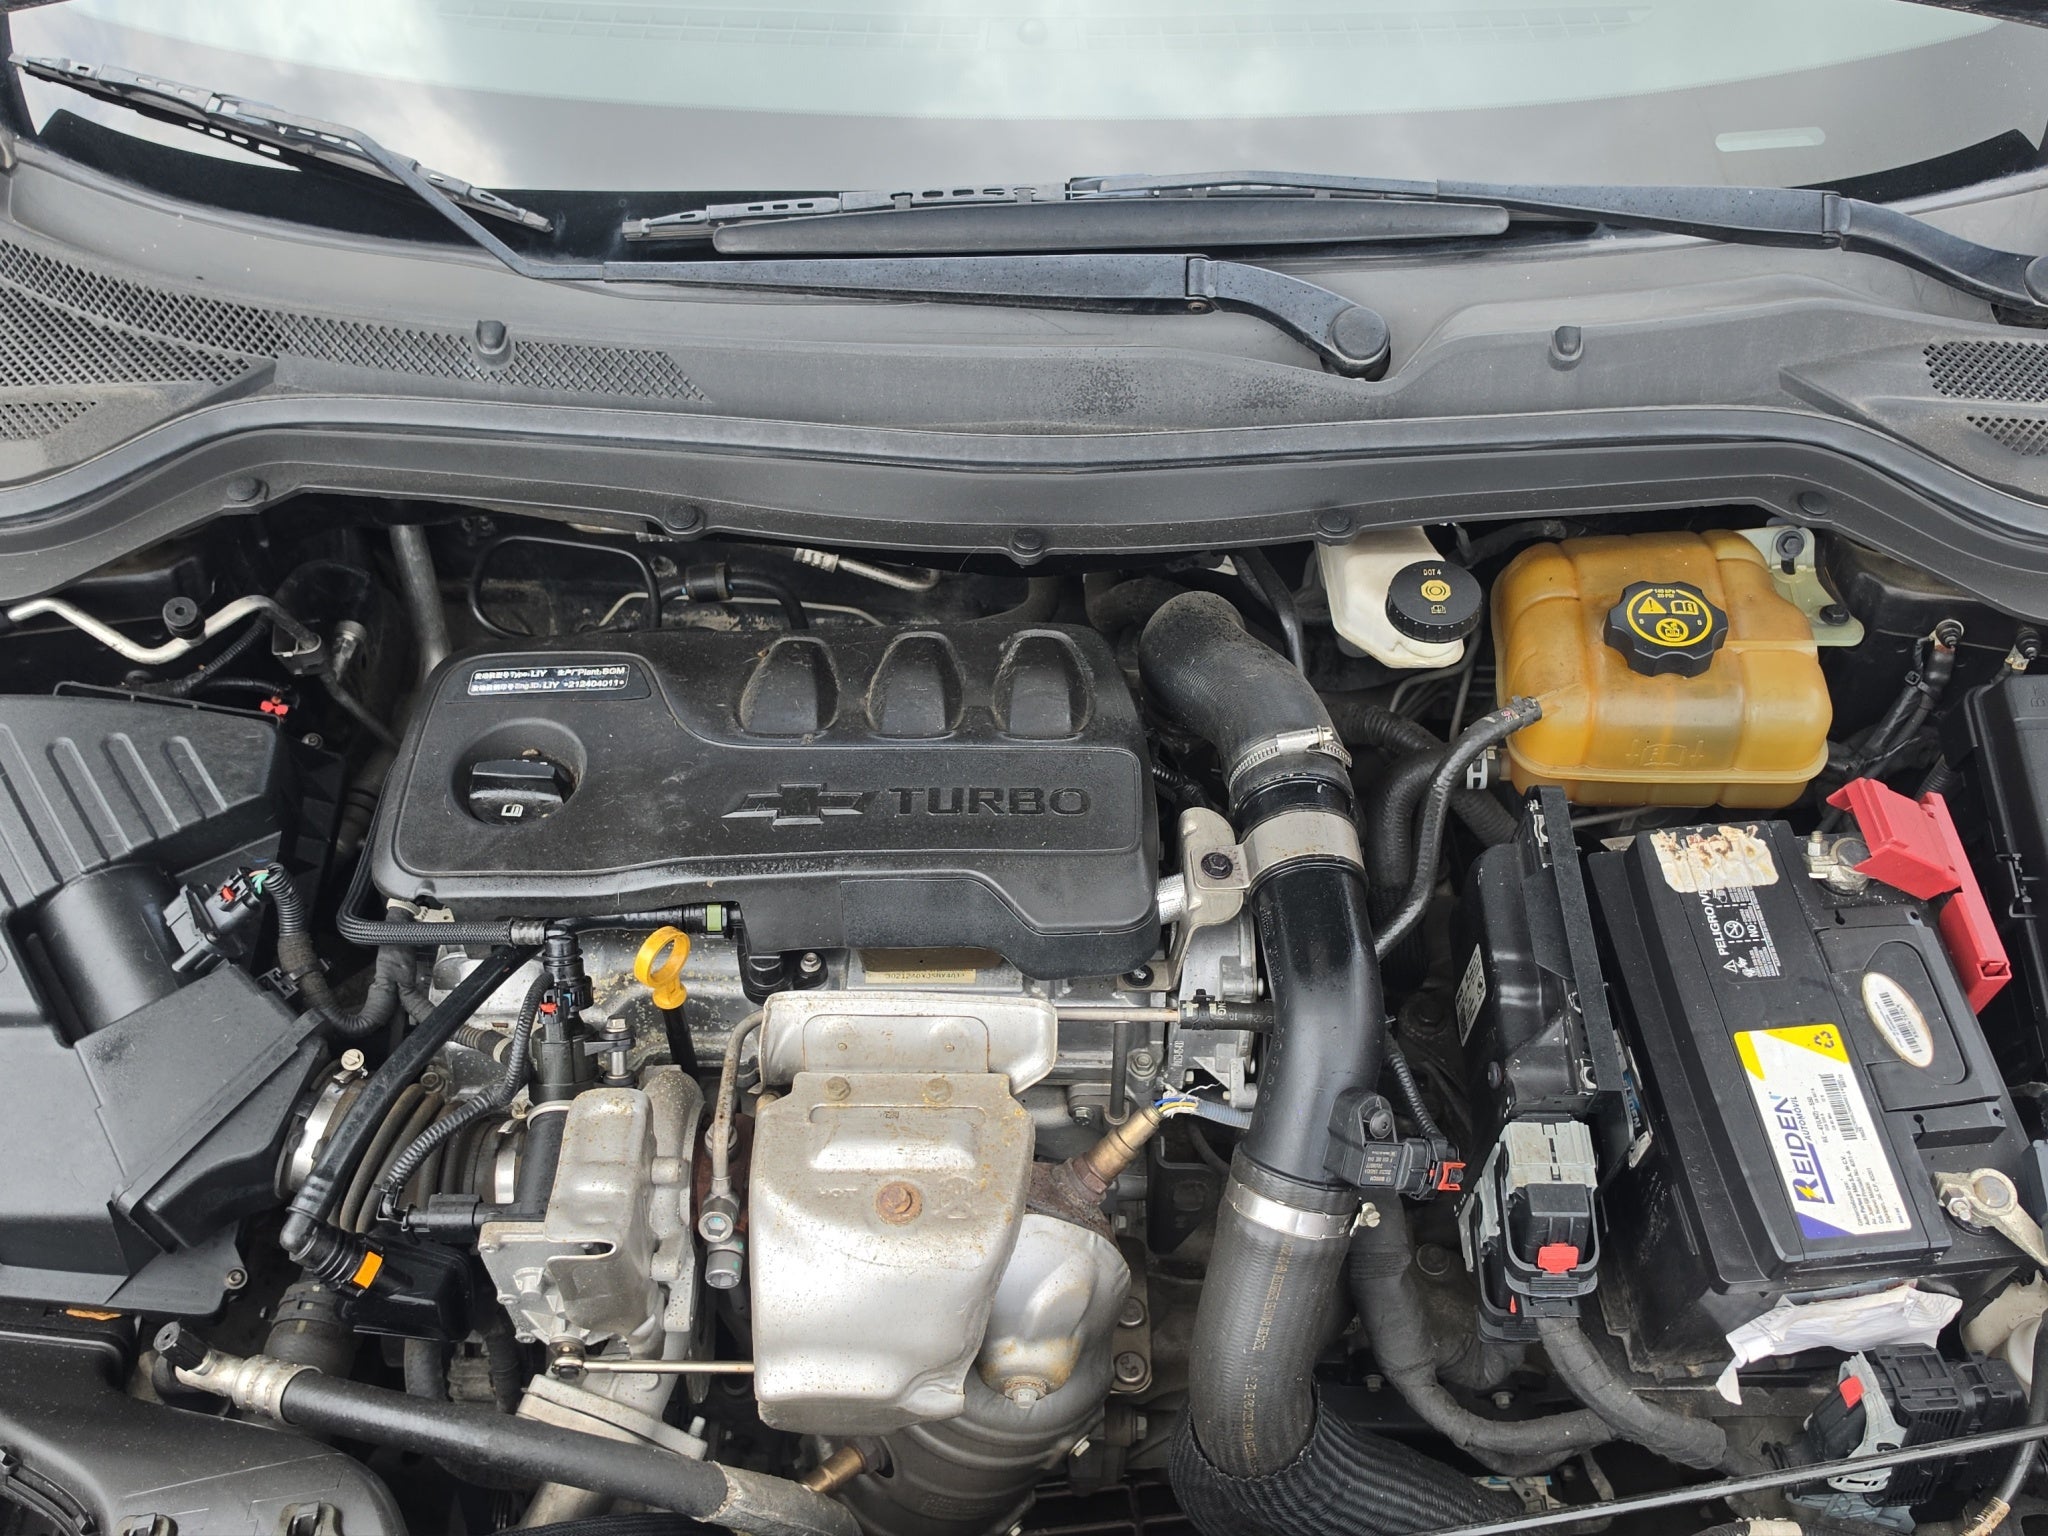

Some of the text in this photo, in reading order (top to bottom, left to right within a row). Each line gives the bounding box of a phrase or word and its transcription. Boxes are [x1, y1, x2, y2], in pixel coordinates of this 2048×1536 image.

[888, 786, 1092, 816] TURBO
[1790, 1096, 1811, 1140] AUTOMÓVIL
[1770, 1094, 1825, 1203] REIDEN
[1847, 1191, 1863, 1226] Comercializado
[1857, 1197, 1866, 1213] Partes
